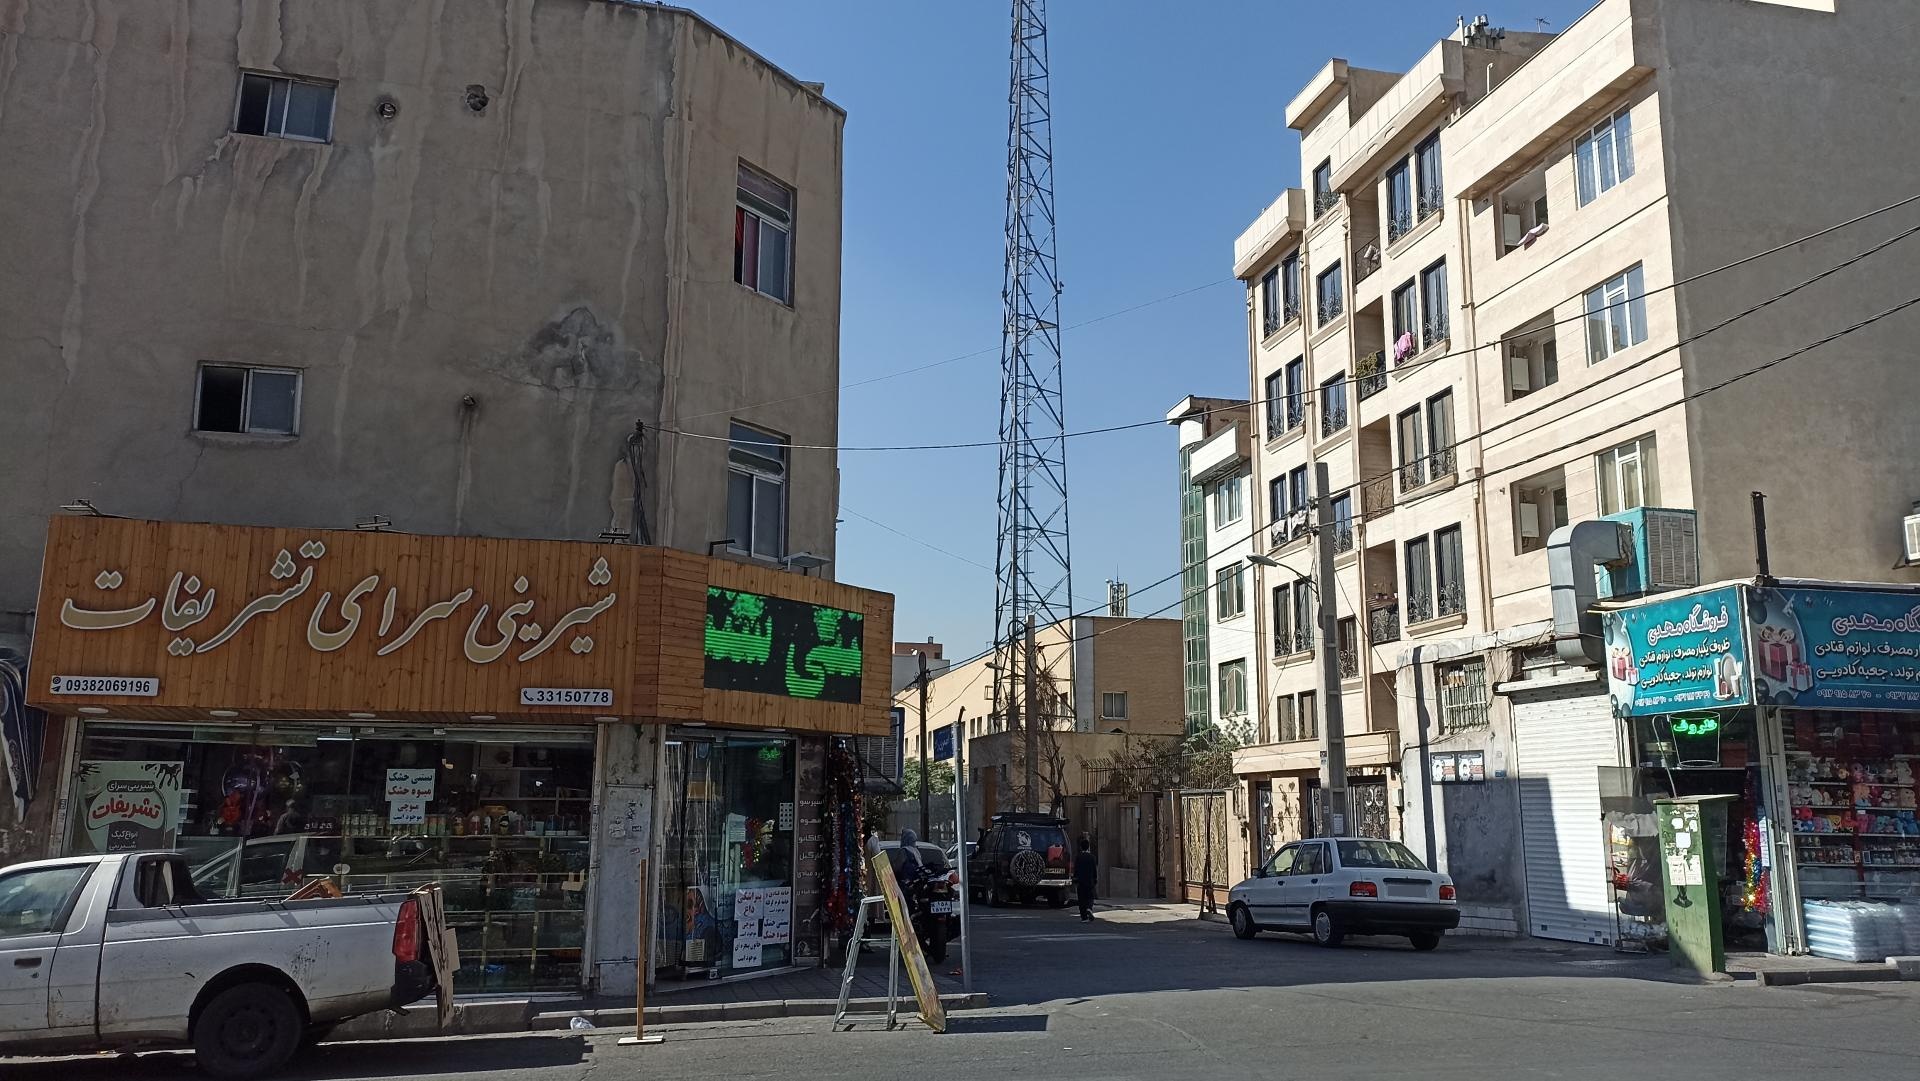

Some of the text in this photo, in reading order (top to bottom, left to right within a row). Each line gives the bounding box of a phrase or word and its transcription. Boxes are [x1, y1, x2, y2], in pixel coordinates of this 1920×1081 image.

[61, 540, 326, 656] تشریفات
[307, 575, 473, 656] سرای
[463, 557, 616, 663] شیرینی
[1648, 603, 1728, 646] فروشگاه مهدی
[1832, 612, 1895, 636] مهدی
[1709, 636, 1731, 653] ظروف
[1814, 640, 1845, 656] قنادی
[1846, 641, 1871, 656] لوازم
[1641, 665, 1666, 689] کادویی
[1664, 669, 1681, 685] جعبه
[1697, 664, 1713, 681] لوازم
[1816, 658, 1861, 679] کادویی
[1858, 665, 1888, 680] جعبه
[66, 679, 150, 693] 09382069196
[536, 690, 609, 703] 33150778
[1672, 718, 1718, 735] ظروف
[108, 782, 155, 792] شیرینی سرای
[388, 772, 432, 785] بستنی خشک
[388, 786, 432, 799] میوه خشک
[92, 794, 161, 820] تشریفات
